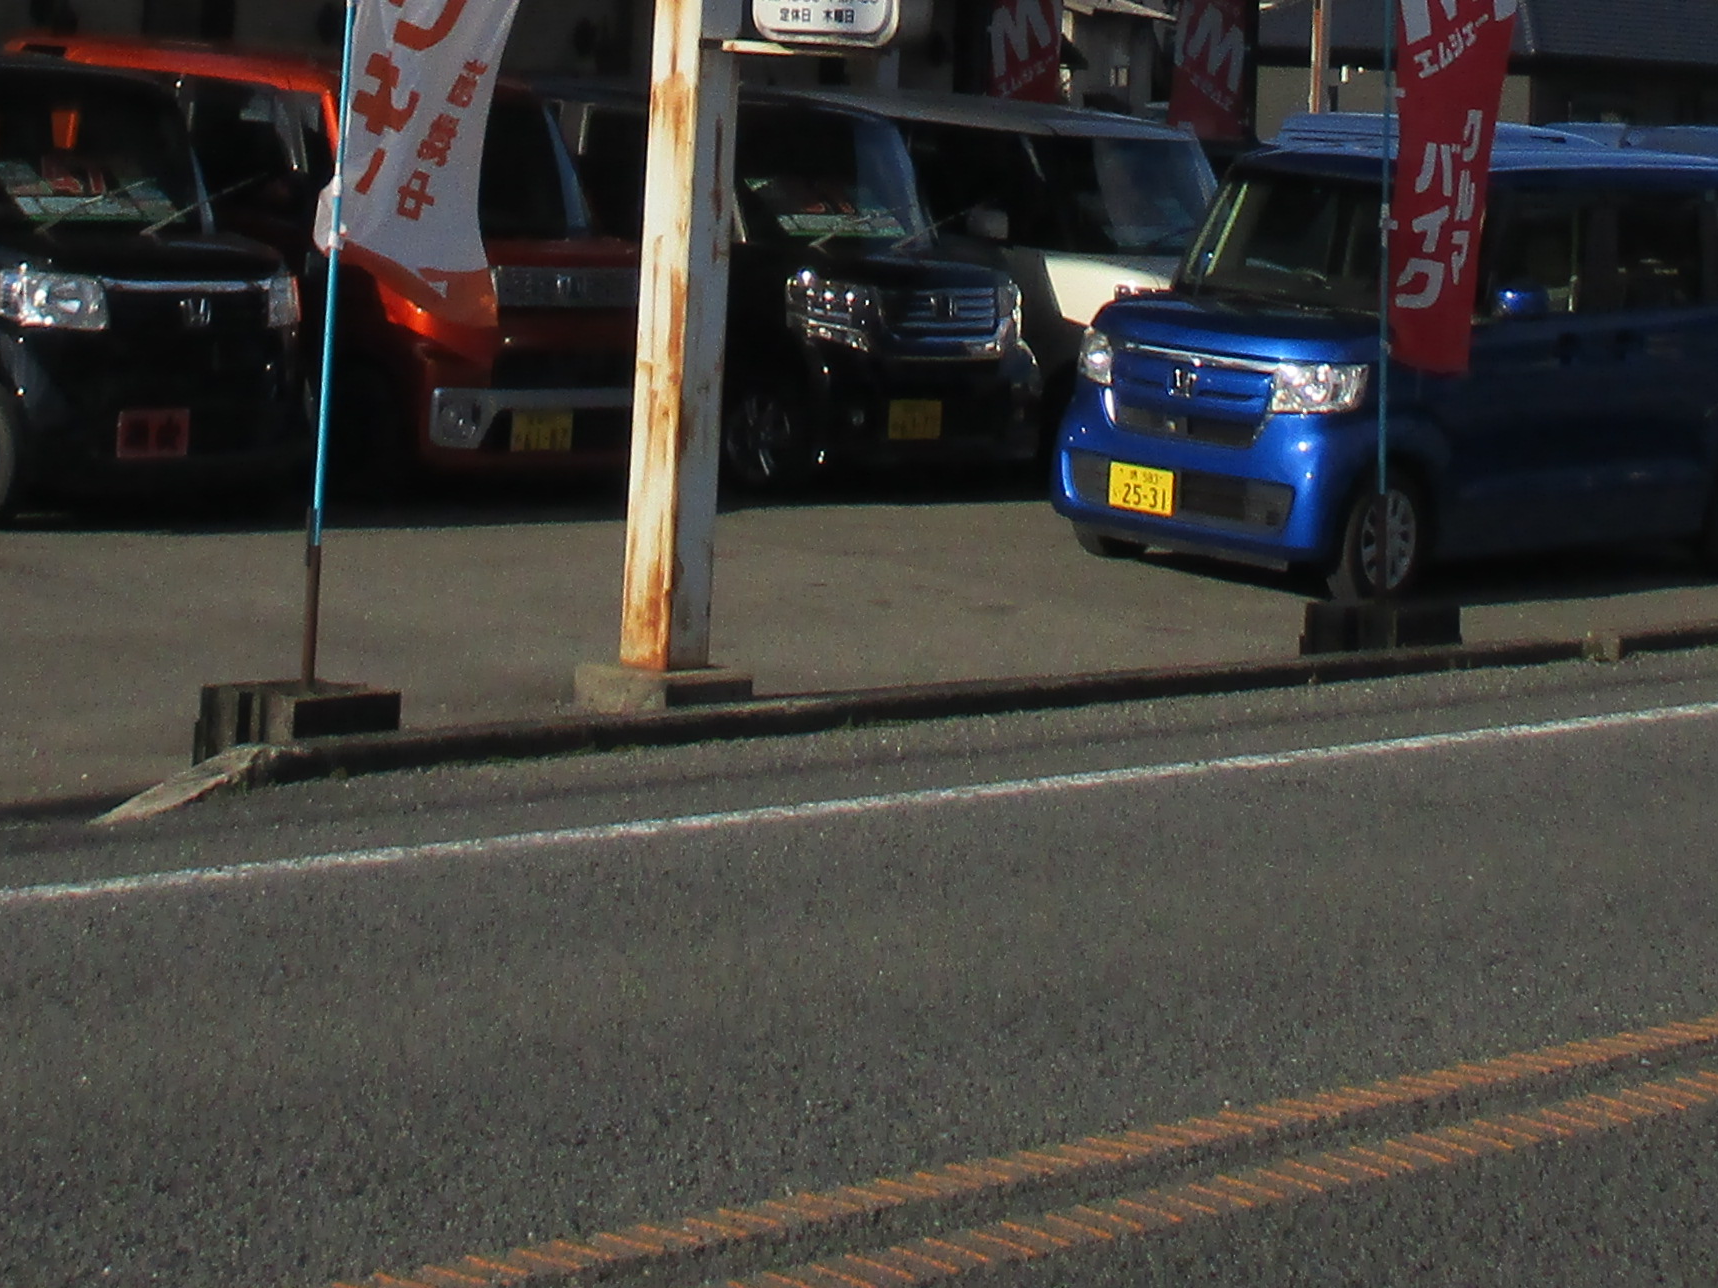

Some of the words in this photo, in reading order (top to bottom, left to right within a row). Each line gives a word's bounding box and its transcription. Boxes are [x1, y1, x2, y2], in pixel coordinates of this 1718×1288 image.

[1395, 141, 1462, 309] バイク
[1452, 109, 1483, 285] クルマ
[1122, 482, 1166, 511] 25-31
